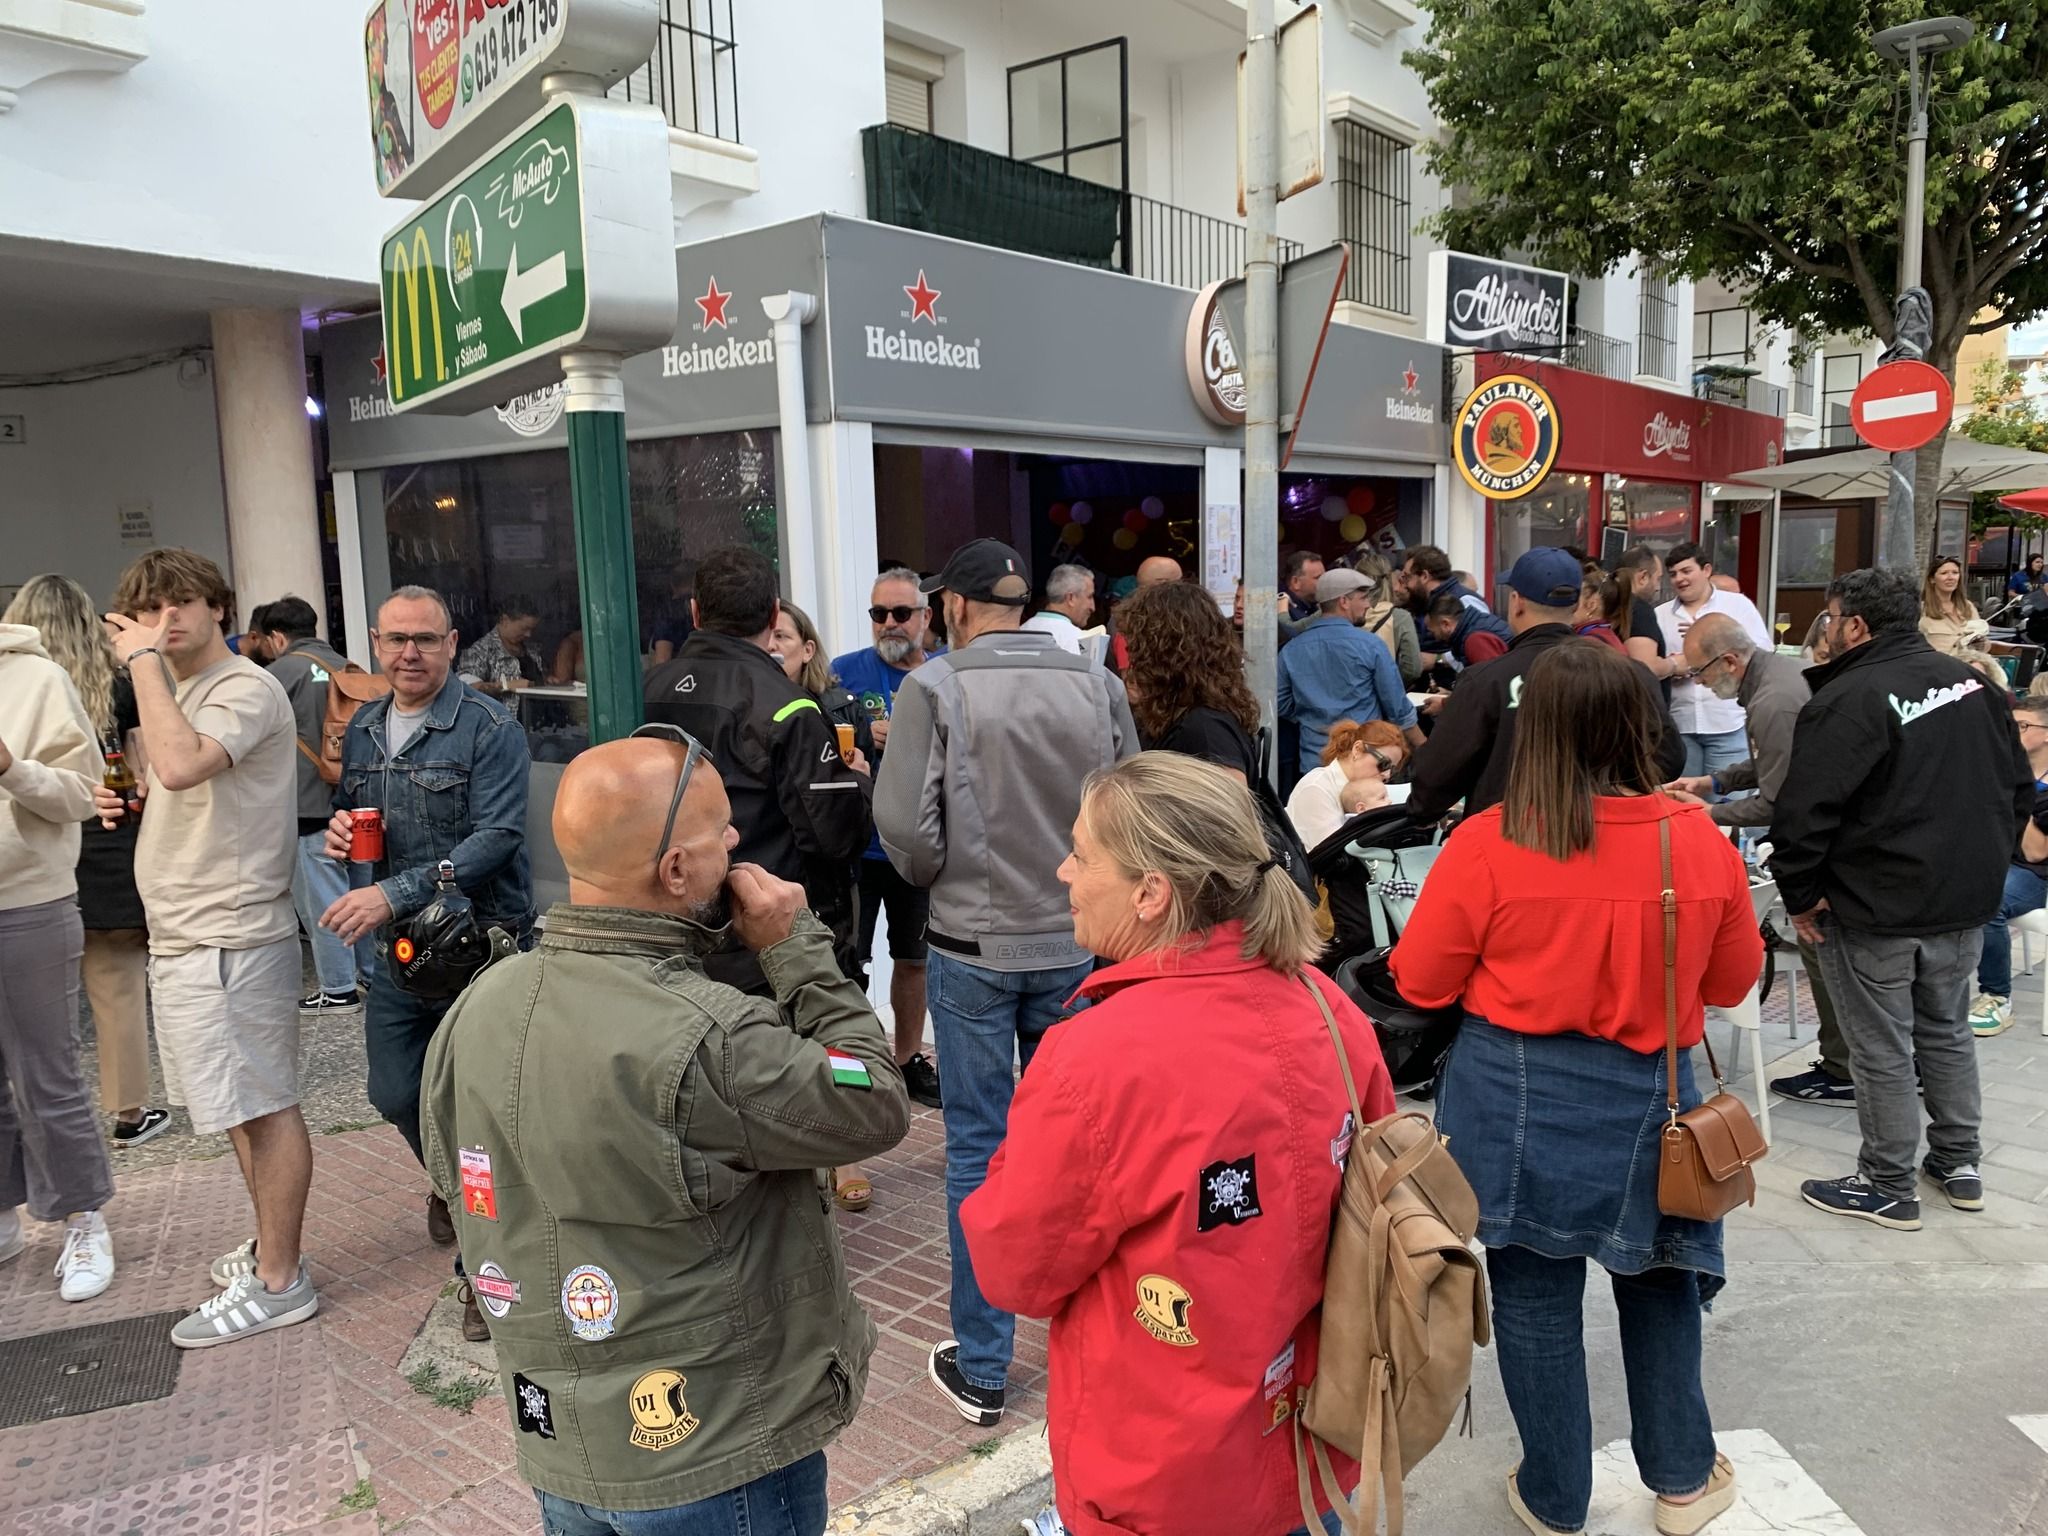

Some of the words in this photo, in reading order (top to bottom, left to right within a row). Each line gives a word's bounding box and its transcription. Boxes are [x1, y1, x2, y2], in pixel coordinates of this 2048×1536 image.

[430, 38, 458, 84] CLIENTES
[474, 26, 498, 92] 619
[502, 0, 527, 67] 472
[512, 154, 553, 201] McAuto
[455, 229, 472, 271] 24
[455, 316, 482, 343] Viernes
[864, 325, 981, 370] Heineken
[461, 342, 488, 368] Sábado
[661, 336, 775, 378] Heineken
[349, 394, 394, 422] Heine
[1386, 397, 1434, 424] Heineken
[1464, 383, 1549, 428] PAULANER
[1470, 460, 1542, 490] MÜNCHEN
[1142, 1286, 1161, 1308] VI
[635, 1393, 656, 1413] VI
[633, 1413, 695, 1449] Vesparoth
